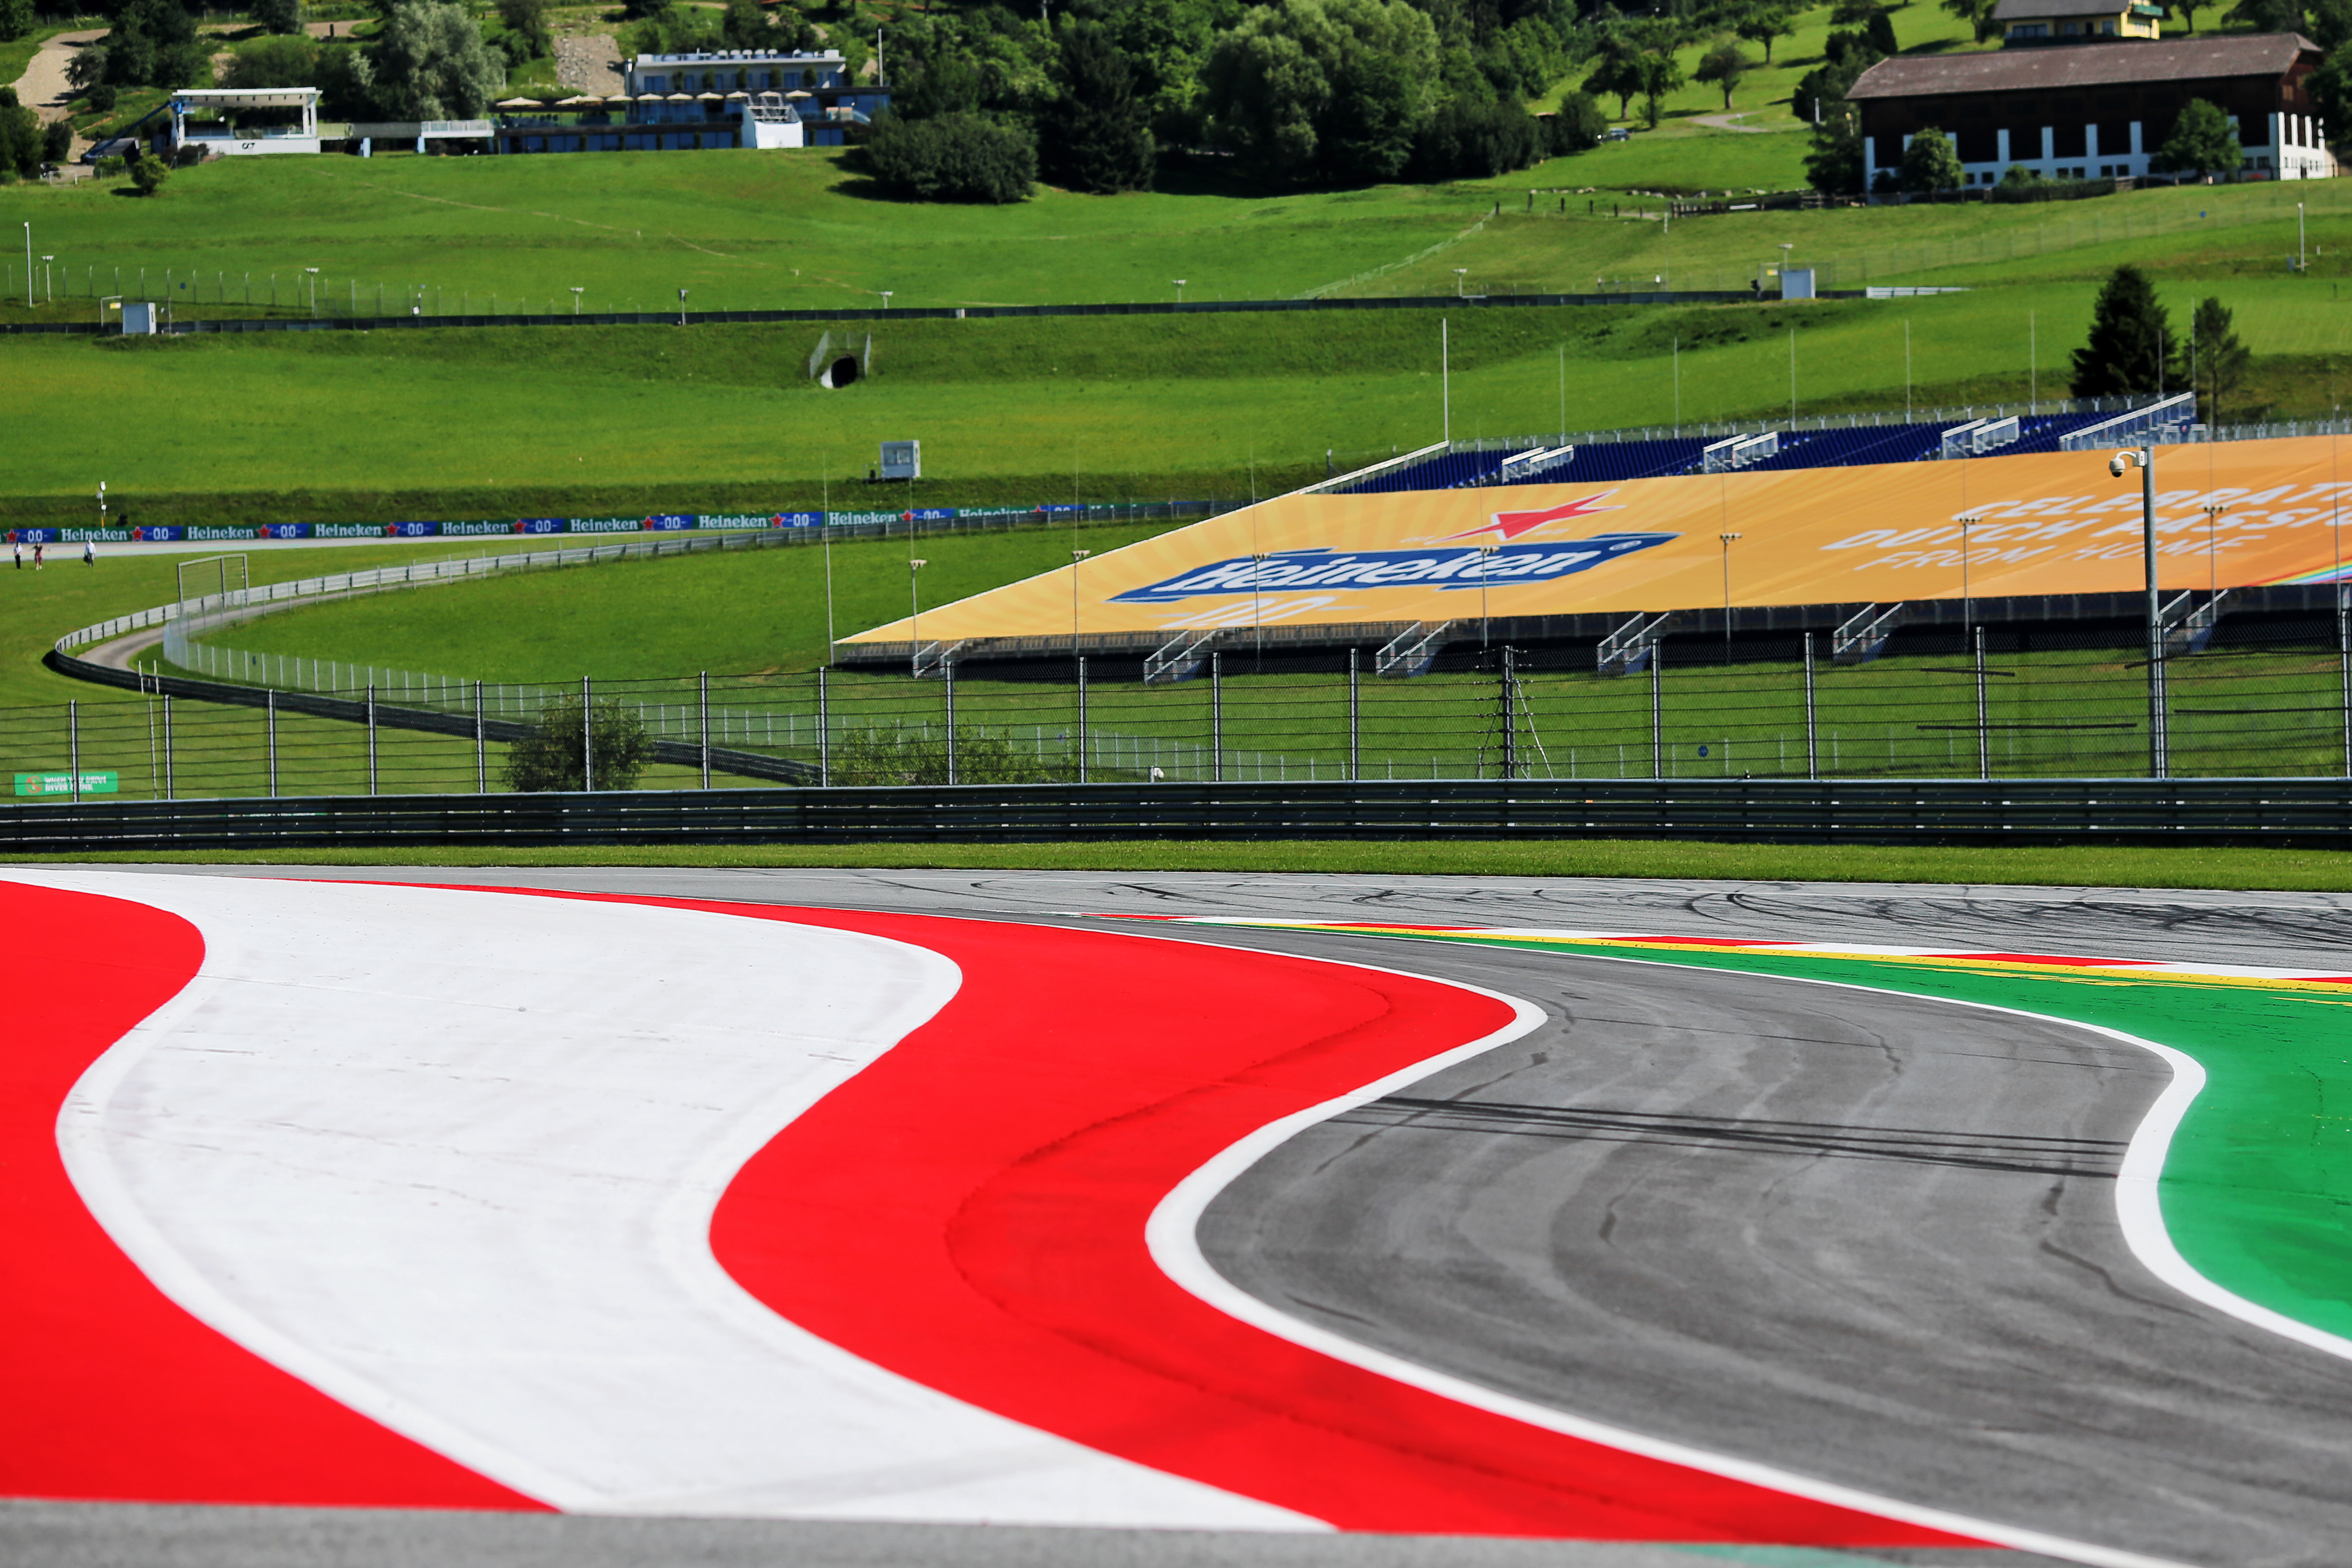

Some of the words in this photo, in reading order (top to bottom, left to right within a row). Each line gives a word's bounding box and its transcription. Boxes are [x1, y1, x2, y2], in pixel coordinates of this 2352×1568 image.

[570, 518, 638, 532] Heineken
[699, 514, 767, 528] Heineken
[828, 511, 897, 525] Heineken
[188, 526, 254, 539] Heineken
[315, 523, 382, 536] Heineken
[442, 520, 509, 535] Heineken
[1819, 518, 2102, 550] DUTCH
[61, 528, 127, 542] Heineken
[1853, 545, 2058, 571] FROM
[2053, 534, 2267, 561] HOME
[1151, 548, 1602, 592] Heineken
